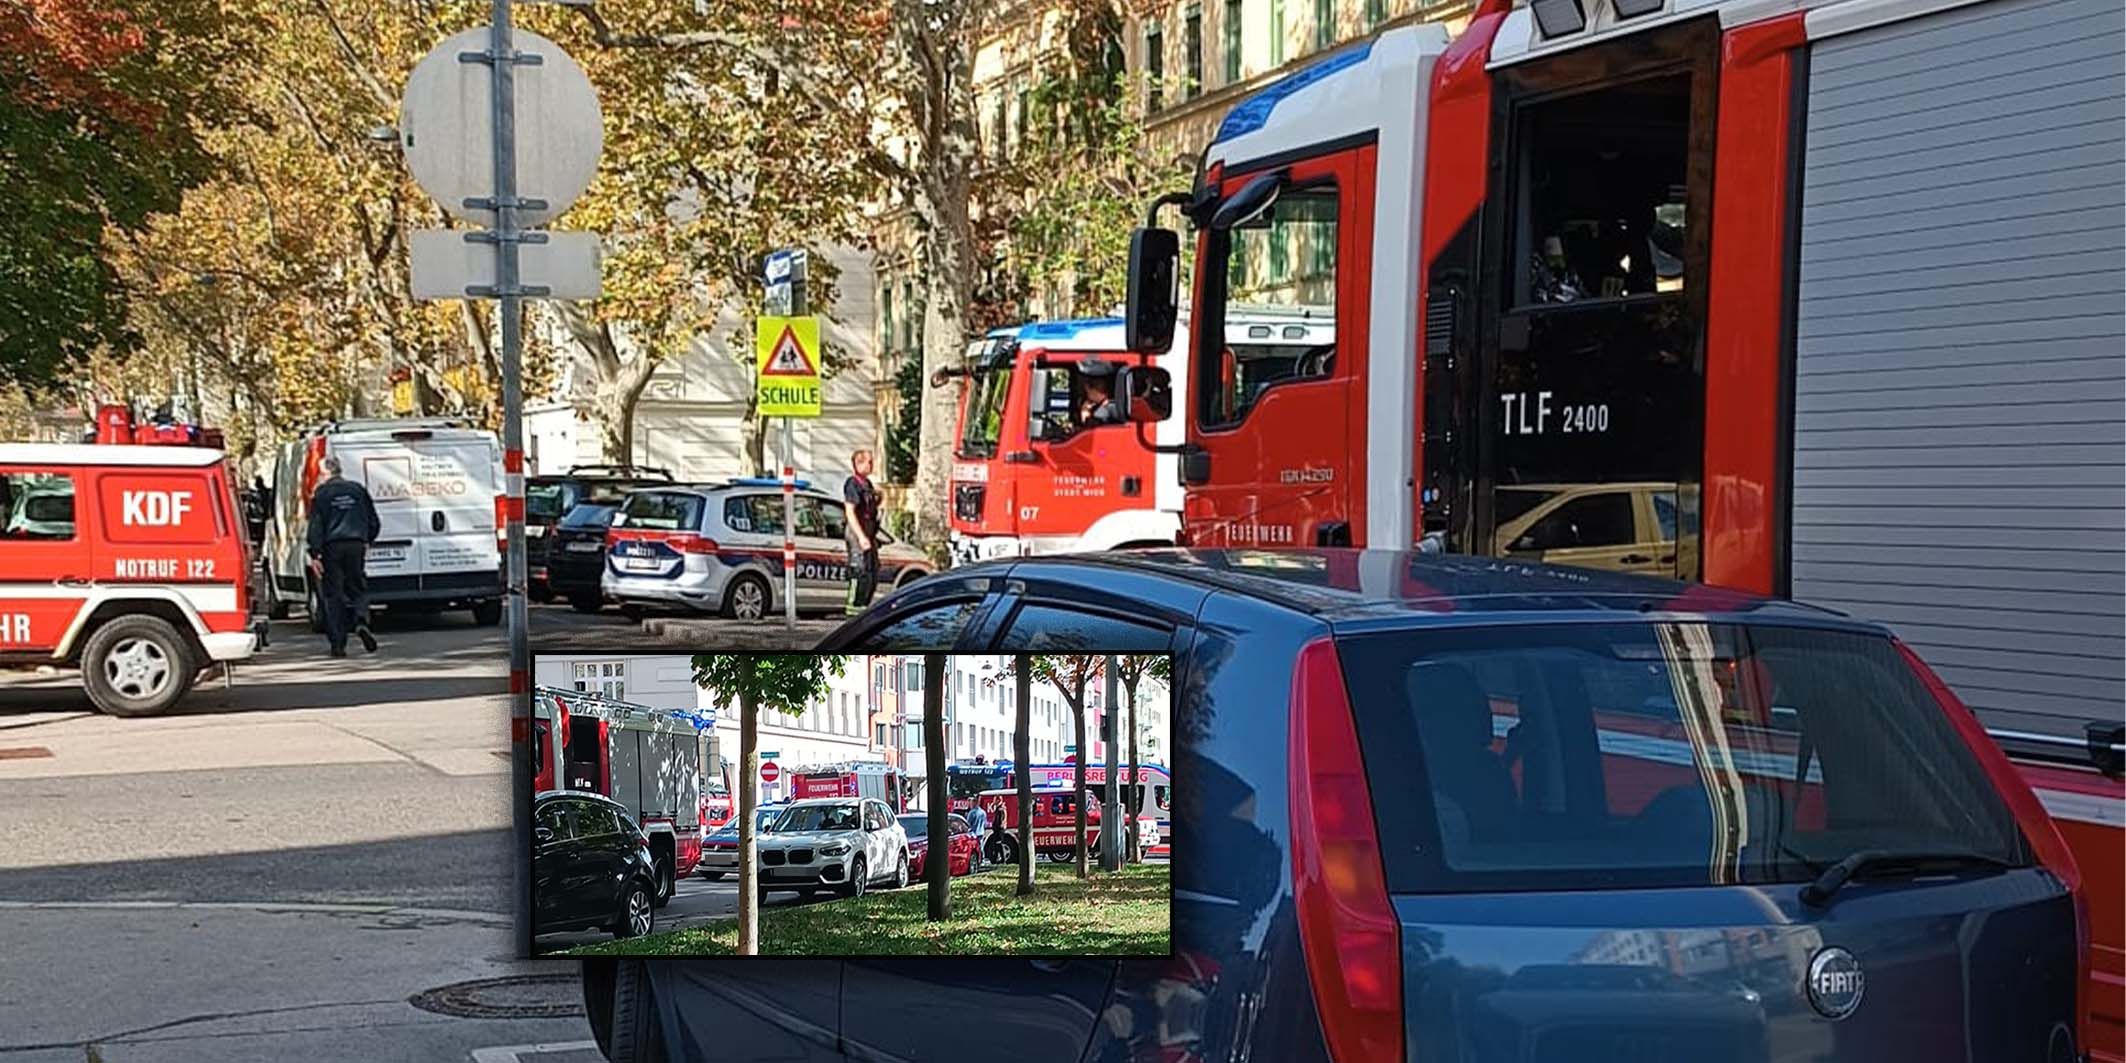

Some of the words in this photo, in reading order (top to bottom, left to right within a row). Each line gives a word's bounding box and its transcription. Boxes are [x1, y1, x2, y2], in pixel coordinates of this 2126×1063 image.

[760, 387, 818, 404] SCHULE
[1501, 391, 1552, 434] TLF
[1563, 405, 1608, 432] 2400
[122, 491, 192, 526] KDF
[1020, 506, 1040, 521] 07
[1225, 524, 1293, 543] FEUERWEHR
[115, 559, 179, 577] NOTRUF
[187, 560, 215, 577] 122
[796, 564, 847, 580] POLIZE
[1034, 835, 1077, 846] EUERWEH
[1821, 970, 1855, 994] FIAT
